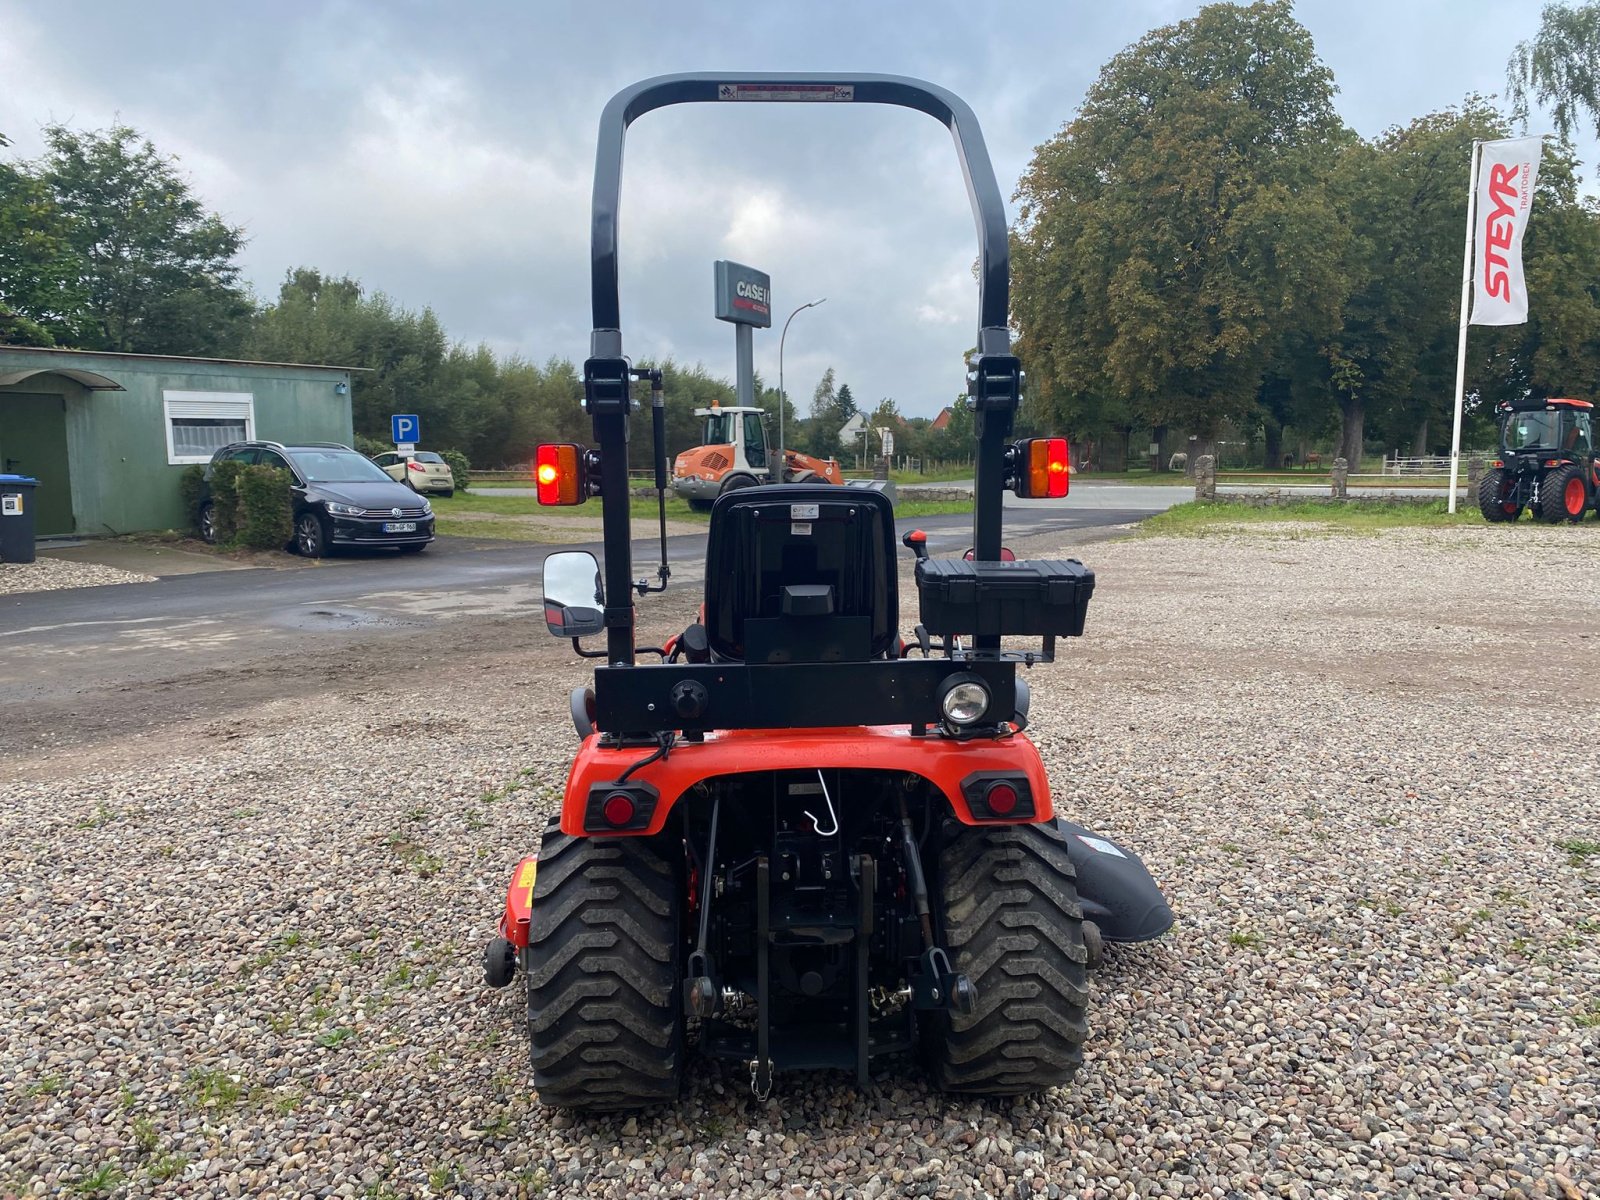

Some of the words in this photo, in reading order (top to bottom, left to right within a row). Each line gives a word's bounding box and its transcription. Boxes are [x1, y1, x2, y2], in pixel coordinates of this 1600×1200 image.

[1520, 162, 1530, 210] TRAKTOREN
[1485, 163, 1519, 303] STEYR
[737, 281, 763, 302] CASE
[398, 418, 413, 440] P
